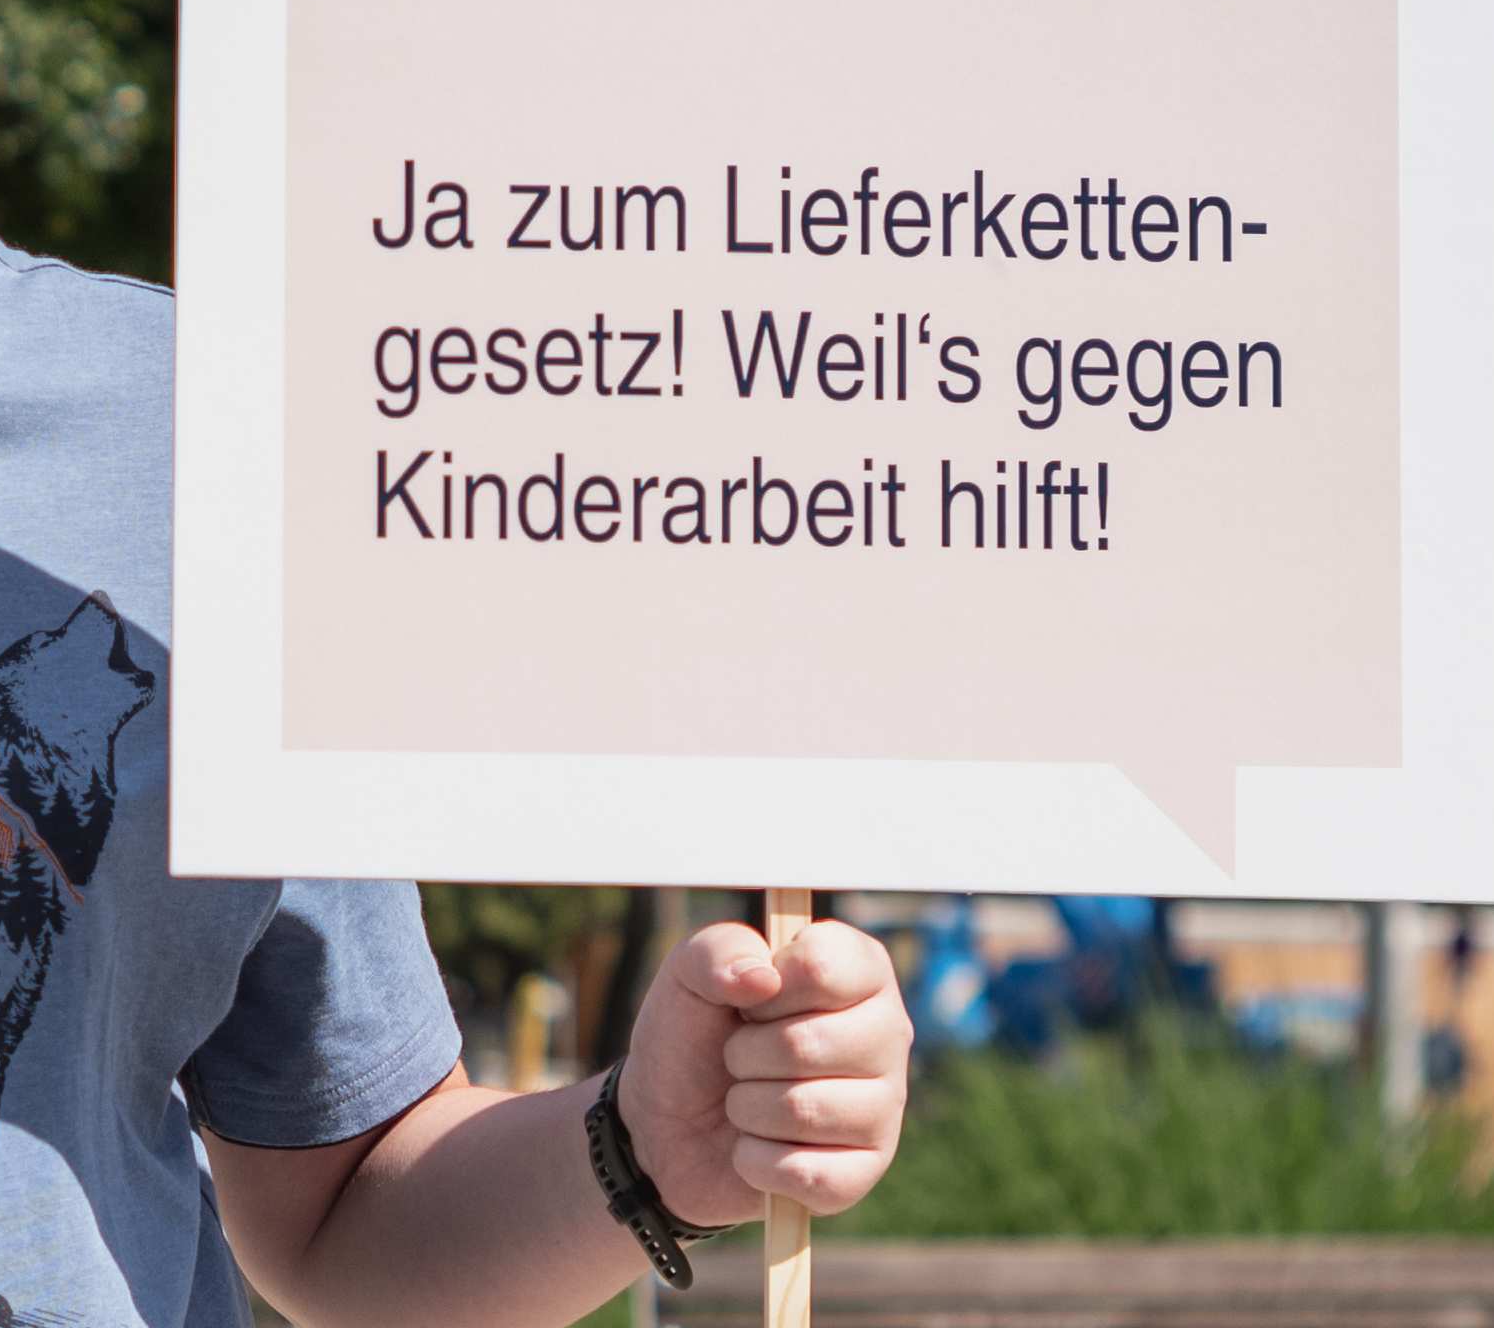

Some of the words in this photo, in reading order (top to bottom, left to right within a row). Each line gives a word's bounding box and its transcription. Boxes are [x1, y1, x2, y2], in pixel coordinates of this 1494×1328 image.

[372, 159, 473, 250] Ja
[506, 184, 686, 252] zum
[726, 164, 1268, 263] Lieferketten-
[374, 308, 684, 419] gesetz!
[1016, 337, 1282, 432] gegen
[376, 450, 906, 548] Kinderarbeit
[941, 459, 1109, 552] hilft!
